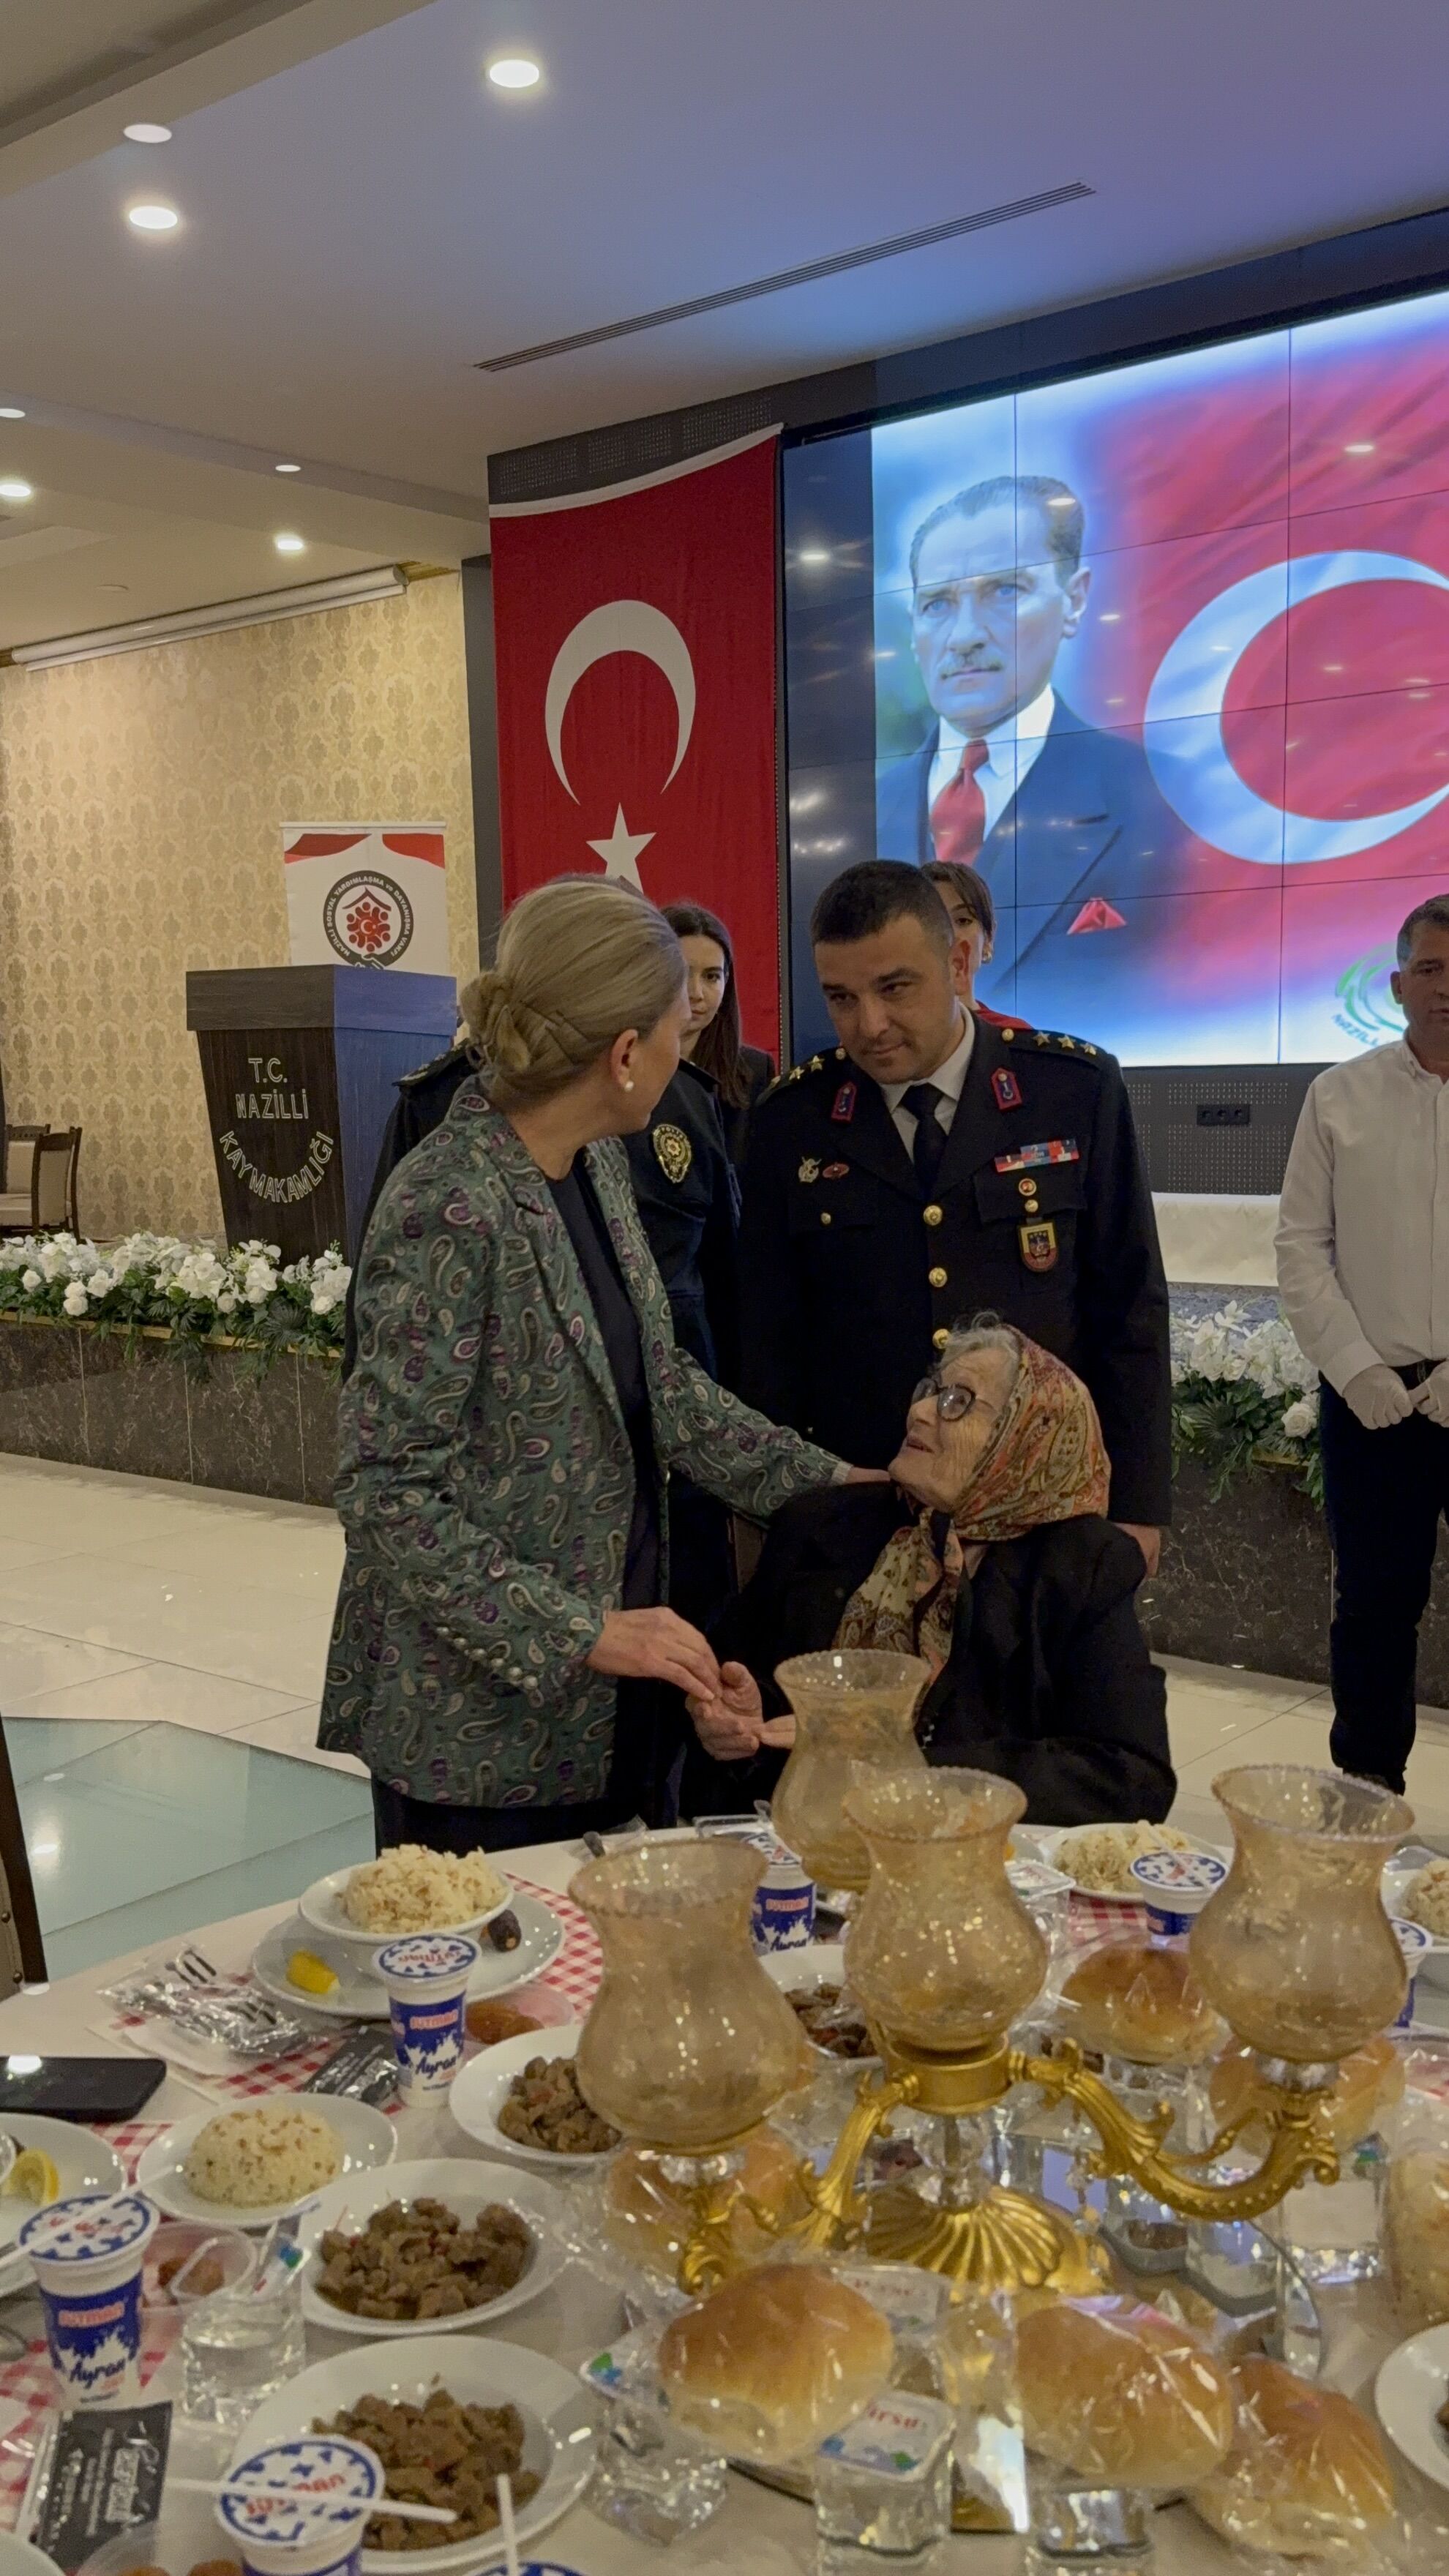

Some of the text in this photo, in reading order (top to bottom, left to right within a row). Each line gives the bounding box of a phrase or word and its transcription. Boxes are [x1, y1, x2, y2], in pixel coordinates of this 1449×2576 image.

[334, 876, 384, 896] YARDIMLAŞMA
[326, 897, 336, 927] SOSYAL
[394, 890, 411, 935] DAYANIŞMA
[390, 937, 408, 956] VAKFI
[248, 1057, 288, 1083] T.C.
[235, 1088, 309, 1119] NAZİLLİ
[220, 1131, 334, 1204] KAYMAKAMLIĞI
[415, 2056, 457, 2079] Ayran
[69, 2359, 126, 2389] Ayran
